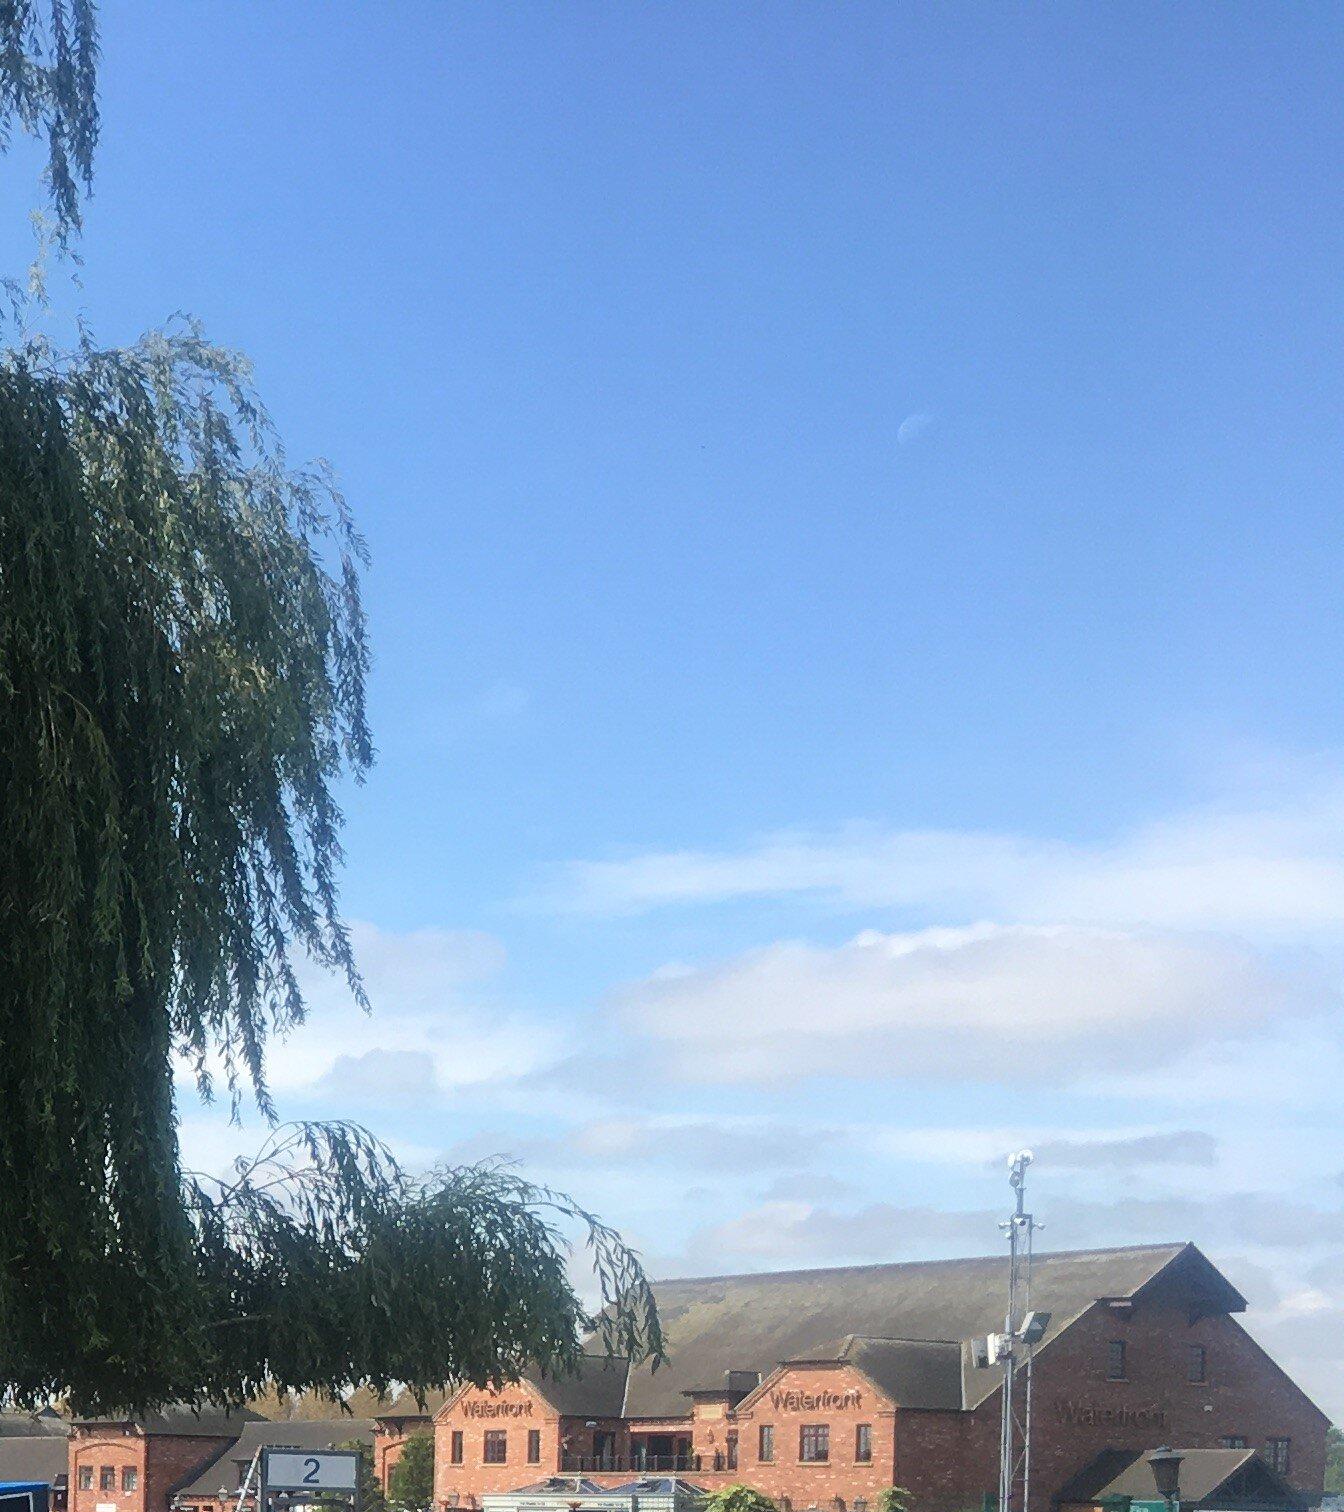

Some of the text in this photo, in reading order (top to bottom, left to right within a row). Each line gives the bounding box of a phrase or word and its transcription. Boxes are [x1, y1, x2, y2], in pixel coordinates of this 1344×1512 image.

[460, 1400, 533, 1419] Waterfront
[771, 1390, 862, 1411] Waterfront
[303, 1458, 320, 1484] 2
